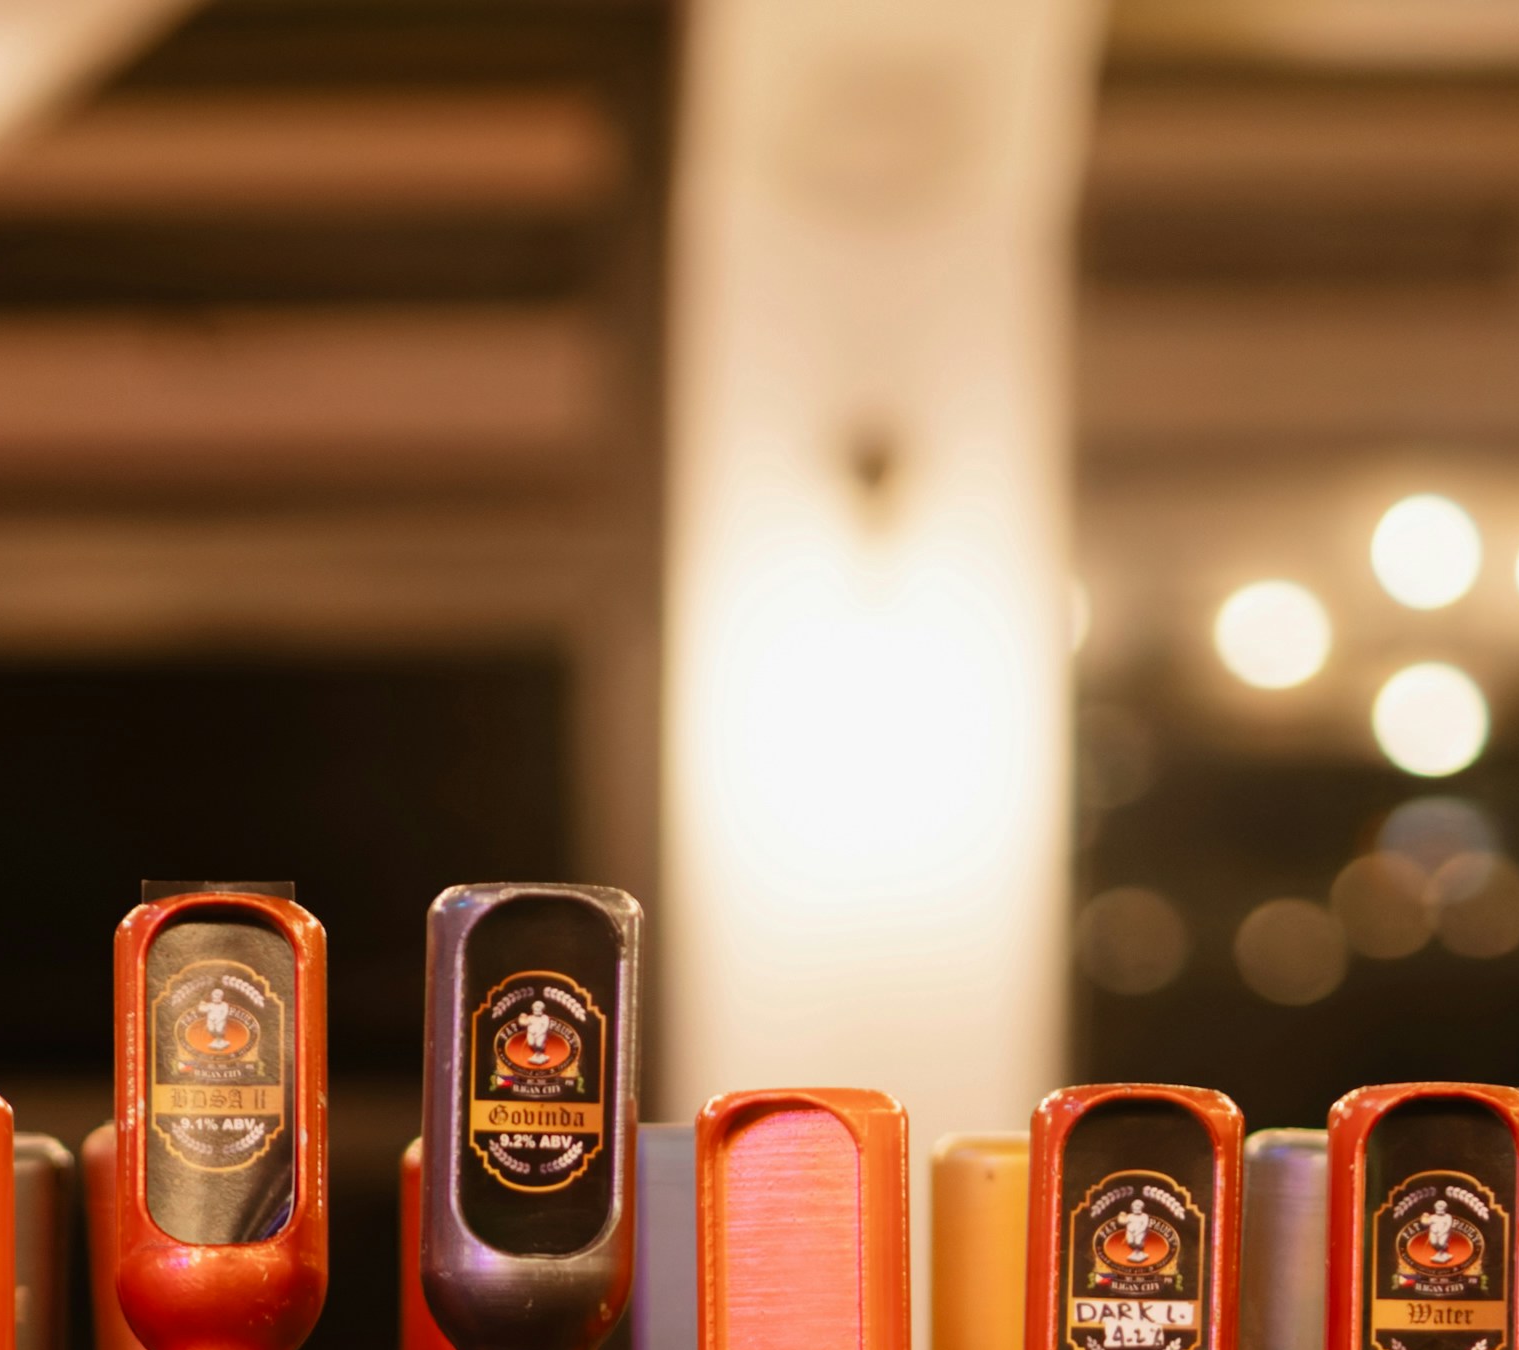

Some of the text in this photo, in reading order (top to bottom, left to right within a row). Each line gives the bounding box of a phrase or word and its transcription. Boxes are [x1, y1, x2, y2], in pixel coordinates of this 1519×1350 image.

[180, 1117, 256, 1130] 9.1% ABV
[488, 1104, 585, 1127] Govinda
[500, 1134, 573, 1149] 9.2% ABV
[1076, 1302, 1155, 1324] DARK
[1407, 1303, 1474, 1325] Water
